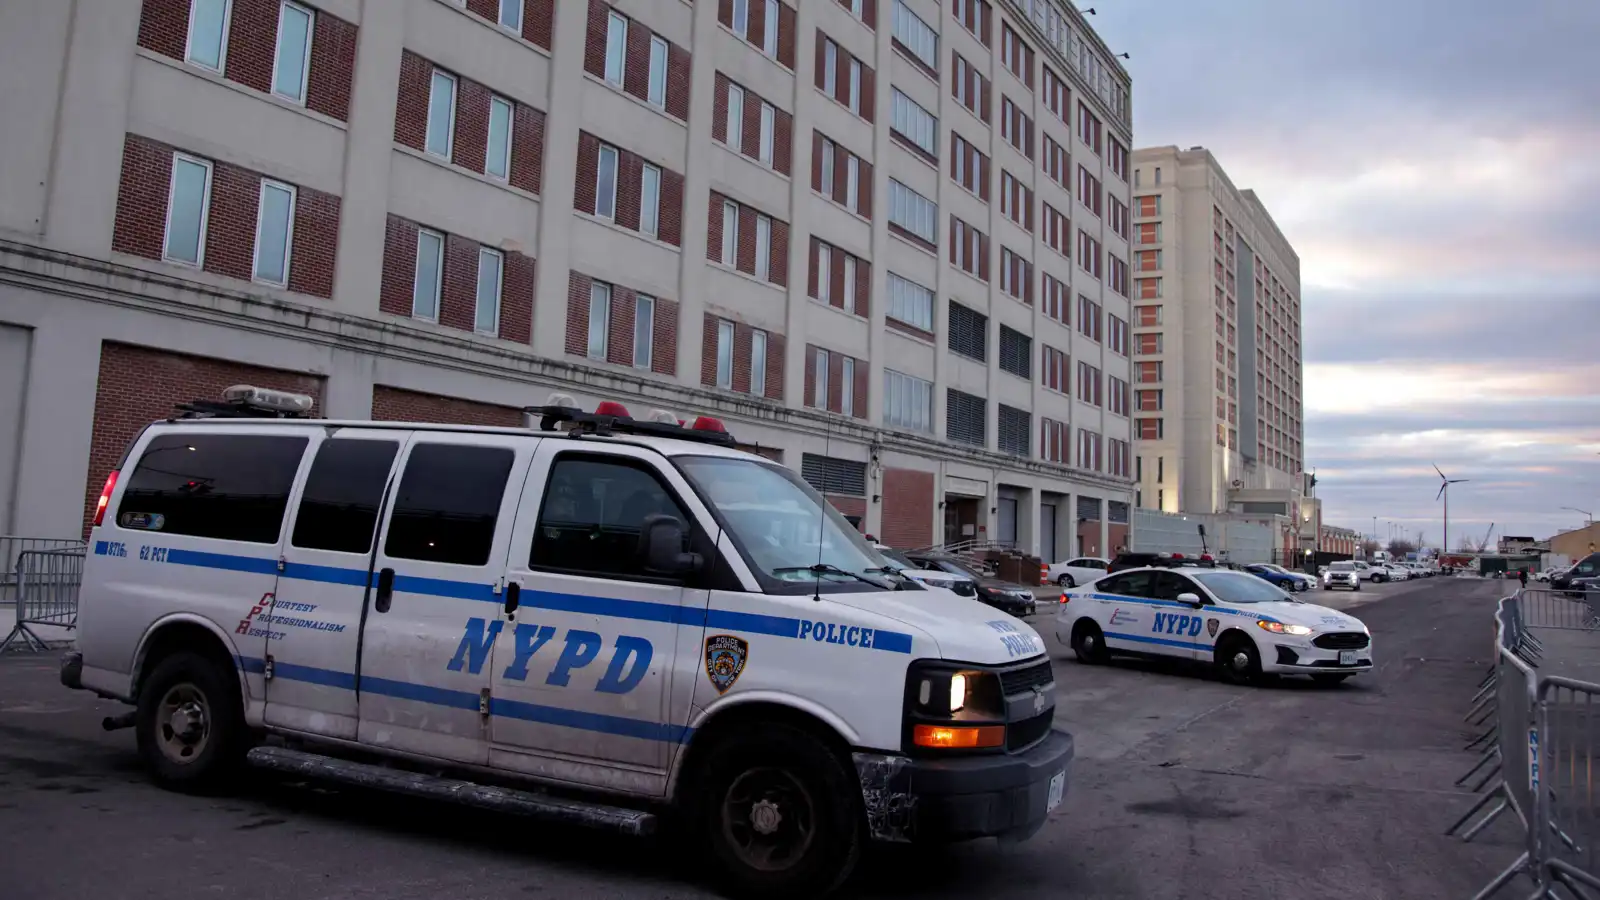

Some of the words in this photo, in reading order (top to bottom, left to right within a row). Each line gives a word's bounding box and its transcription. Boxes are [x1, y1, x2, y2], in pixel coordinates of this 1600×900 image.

[139, 545, 150, 561] 62
[151, 546, 167, 562] PCT
[259, 592, 318, 612] COURTESY
[235, 620, 286, 640] RESPECT
[246, 606, 346, 632] PROFESSIONALISM
[1152, 612, 1202, 636] NYPD
[799, 619, 873, 648] POLICE
[446, 617, 653, 695] NYPD
[708, 645, 745, 654] DEPARTMENT
